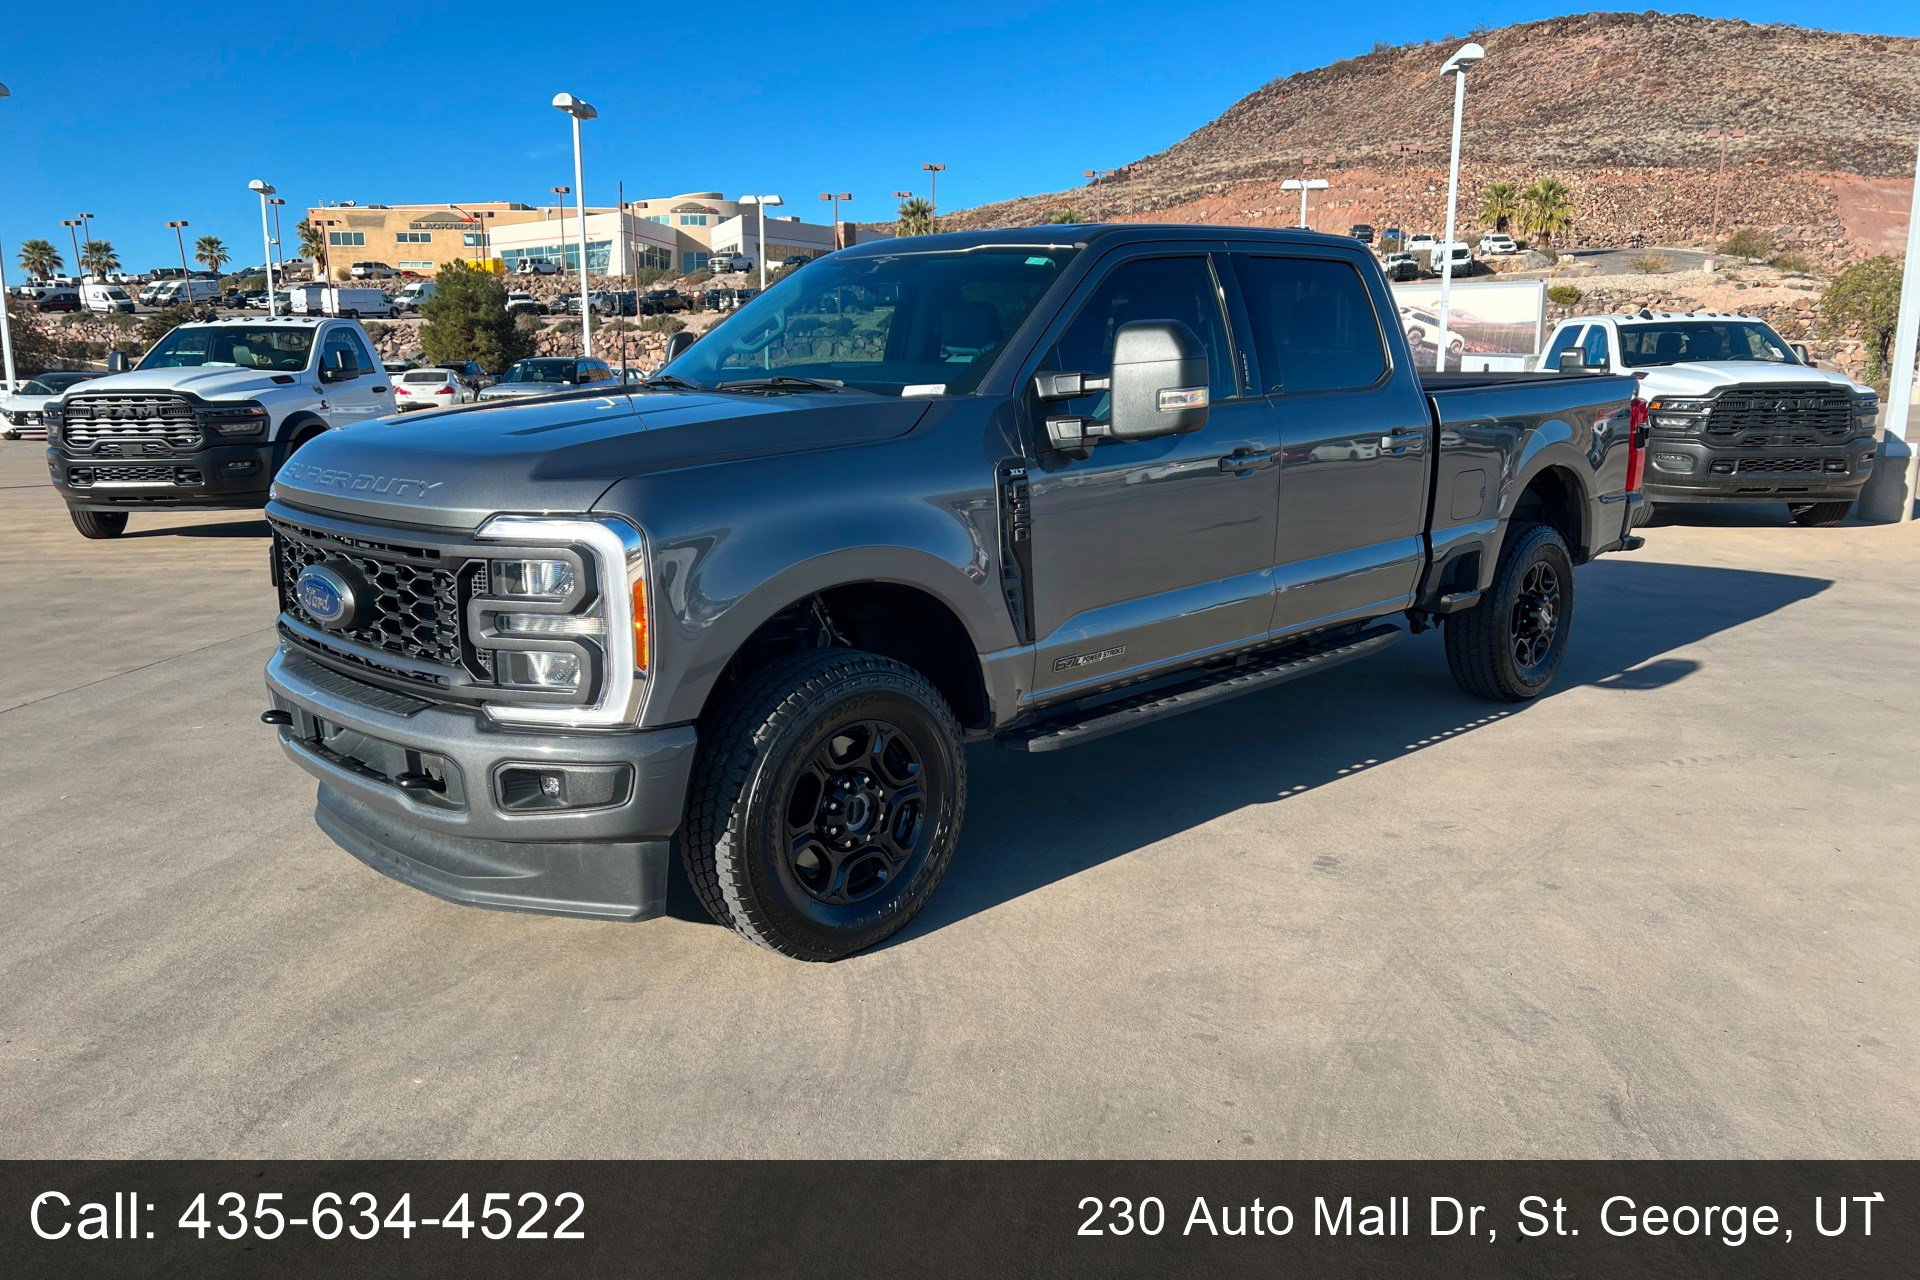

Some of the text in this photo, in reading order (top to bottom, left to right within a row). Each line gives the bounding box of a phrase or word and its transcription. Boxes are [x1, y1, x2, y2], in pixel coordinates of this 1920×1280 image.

[92, 405, 158, 418] RAM
[1010, 468, 1025, 476] XLT
[350, 473, 443, 498] DUTY
